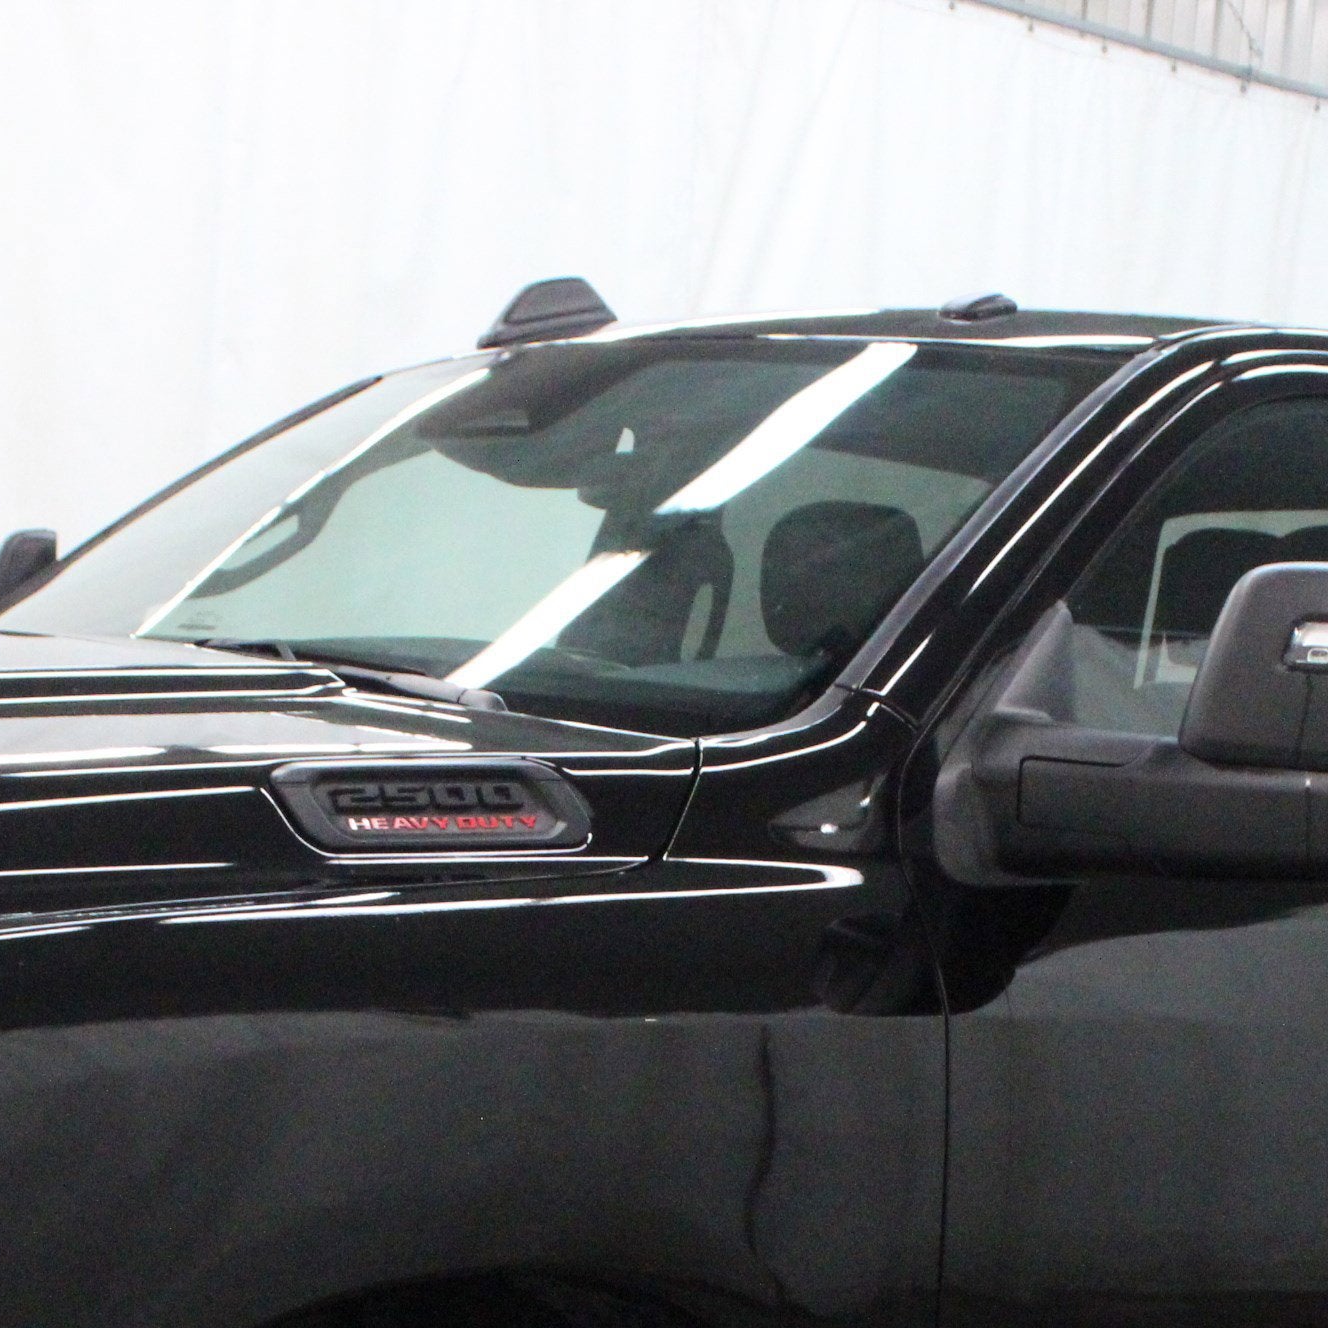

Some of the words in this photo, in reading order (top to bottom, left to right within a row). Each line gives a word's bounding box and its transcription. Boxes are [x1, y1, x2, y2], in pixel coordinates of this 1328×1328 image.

[329, 784, 524, 814] 2500
[348, 816, 450, 831] HEAVY
[457, 816, 538, 829] DUTY
